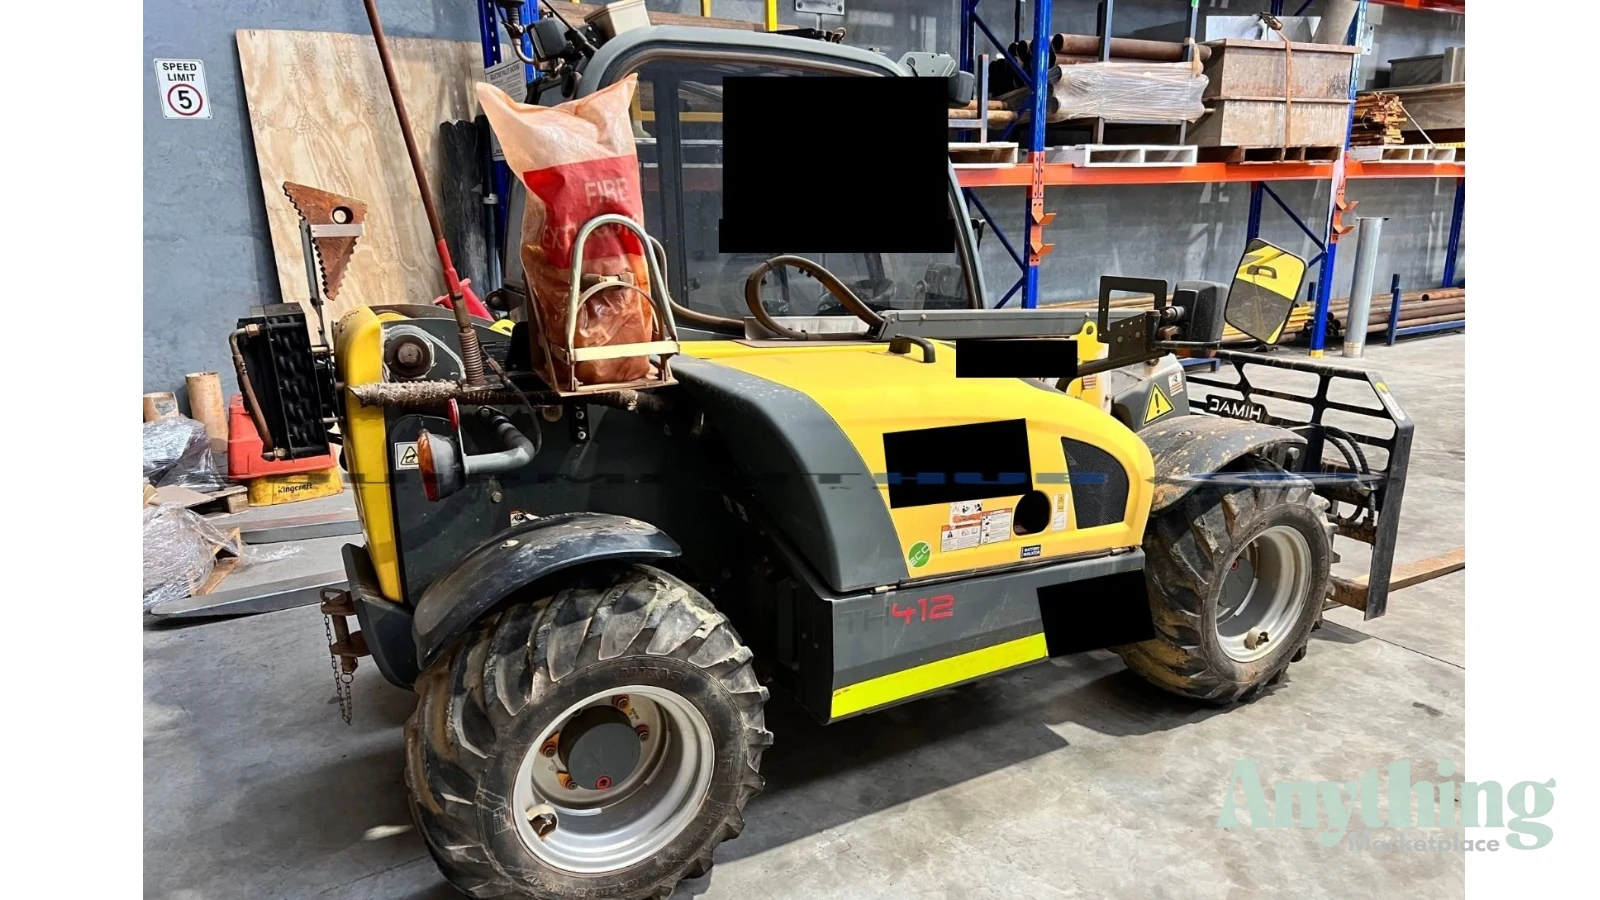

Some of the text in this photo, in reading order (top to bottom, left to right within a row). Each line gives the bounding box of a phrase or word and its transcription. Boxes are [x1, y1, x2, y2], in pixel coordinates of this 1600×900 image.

[162, 62, 197, 71] SPEED
[167, 73, 196, 82] LIMIT
[177, 90, 192, 110] 5
[584, 178, 629, 207] FIRE
